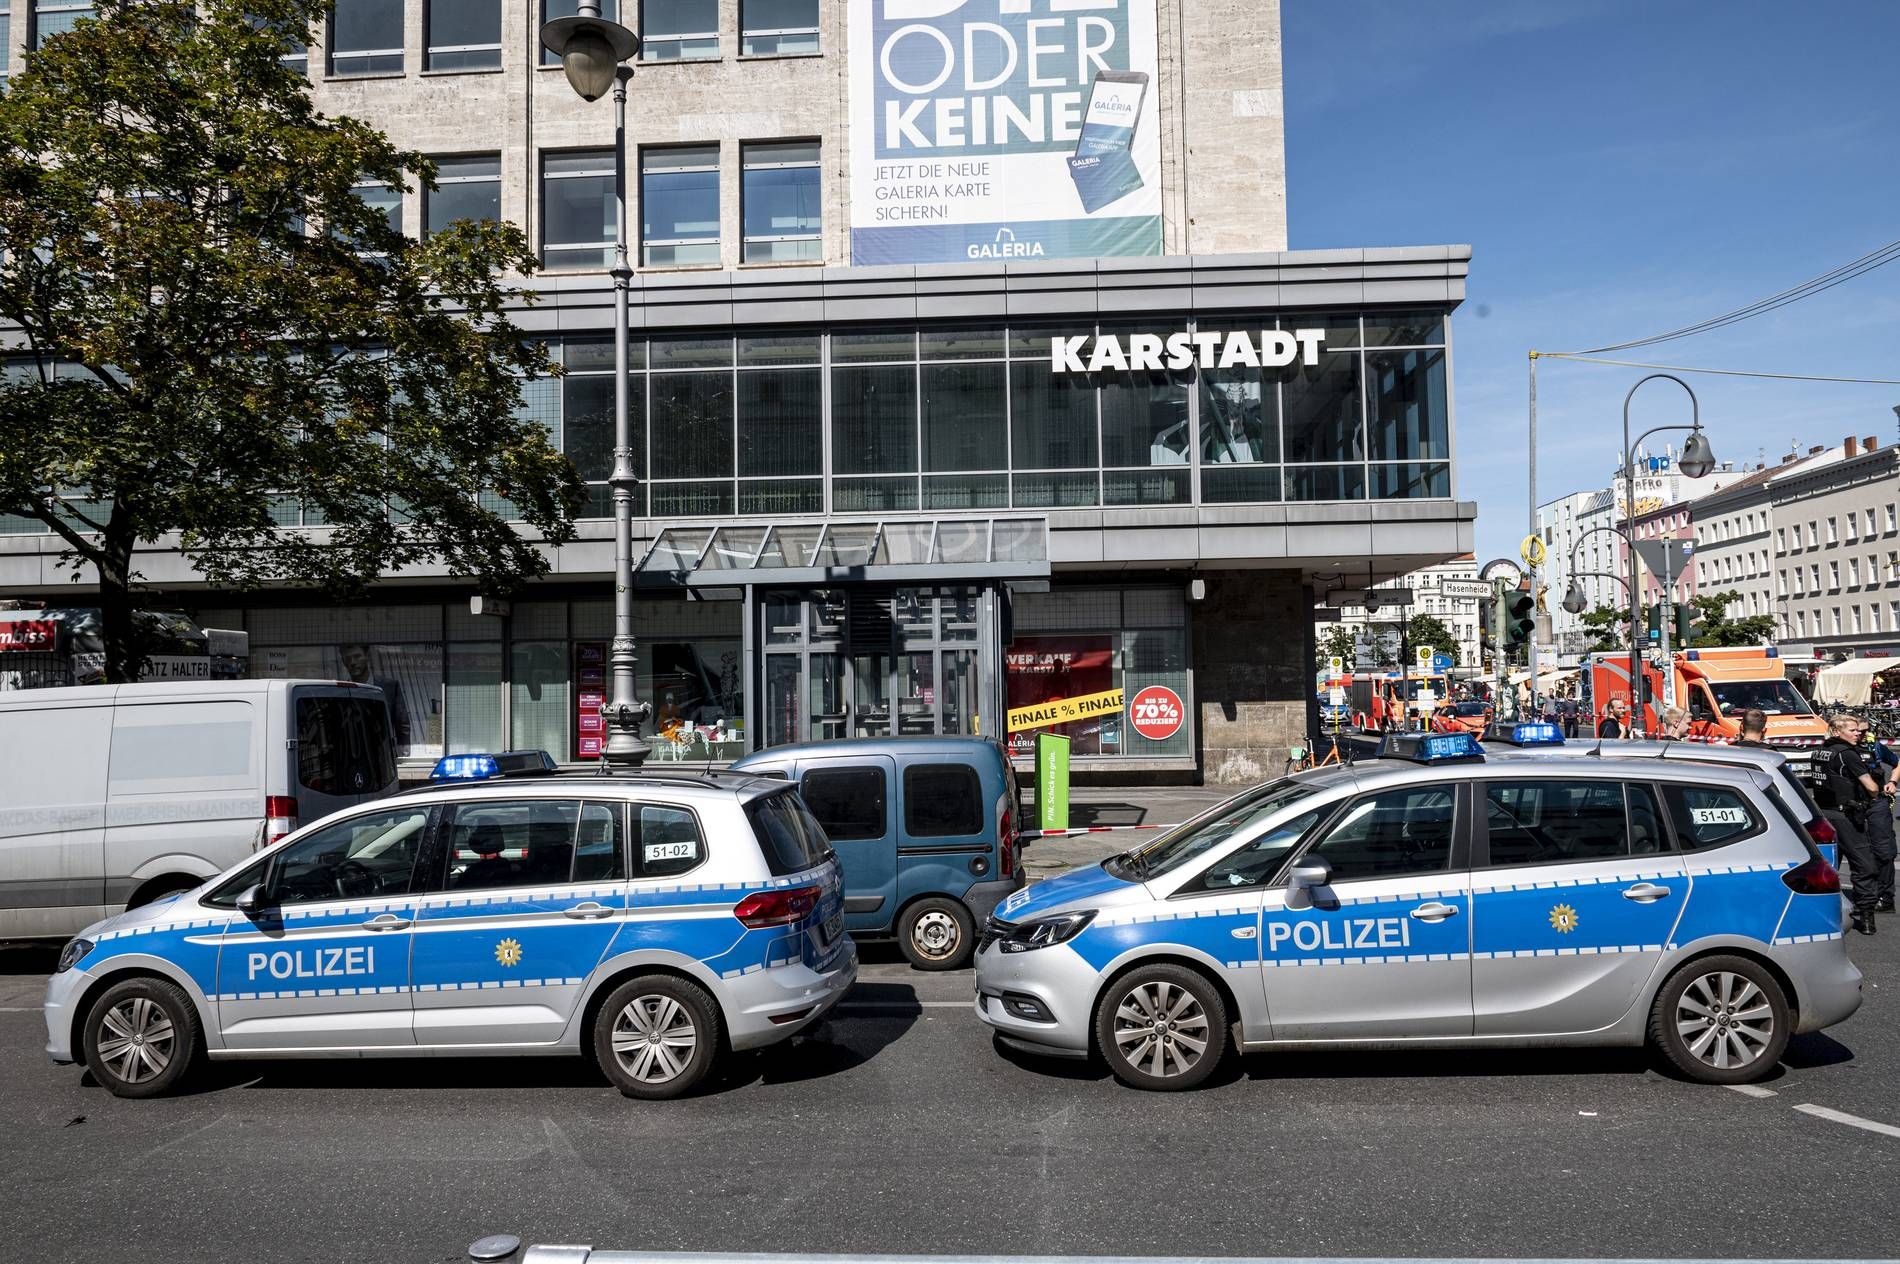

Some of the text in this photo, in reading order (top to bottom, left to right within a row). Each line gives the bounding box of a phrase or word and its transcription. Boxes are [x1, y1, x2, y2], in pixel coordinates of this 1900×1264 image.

[880, 16, 1116, 95] ODER
[885, 92, 1081, 149] KEINE
[873, 162, 990, 181] JETZT DIE NEUE
[875, 183, 990, 200] GALERIA KARTE
[875, 205, 948, 221] SICHERN!
[967, 242, 1045, 259] GALERIA
[1051, 328, 1326, 373] KARSTADT
[1446, 583, 1488, 594] Hasenheide
[0, 628, 47, 644] mbiss
[1007, 653, 1072, 666] VERKAUF
[140, 662, 209, 677] LATZ HALTER
[1610, 688, 1631, 701] NOTRU
[1012, 694, 1123, 726] FINALE % FINALE
[1135, 703, 1178, 718] 70%
[1135, 718, 1178, 726] REDUZIERT
[1700, 810, 1736, 822] 51-01
[653, 844, 689, 858] 51-02
[1268, 917, 1410, 952] POLIZEI
[248, 946, 375, 980] POLIZEI
